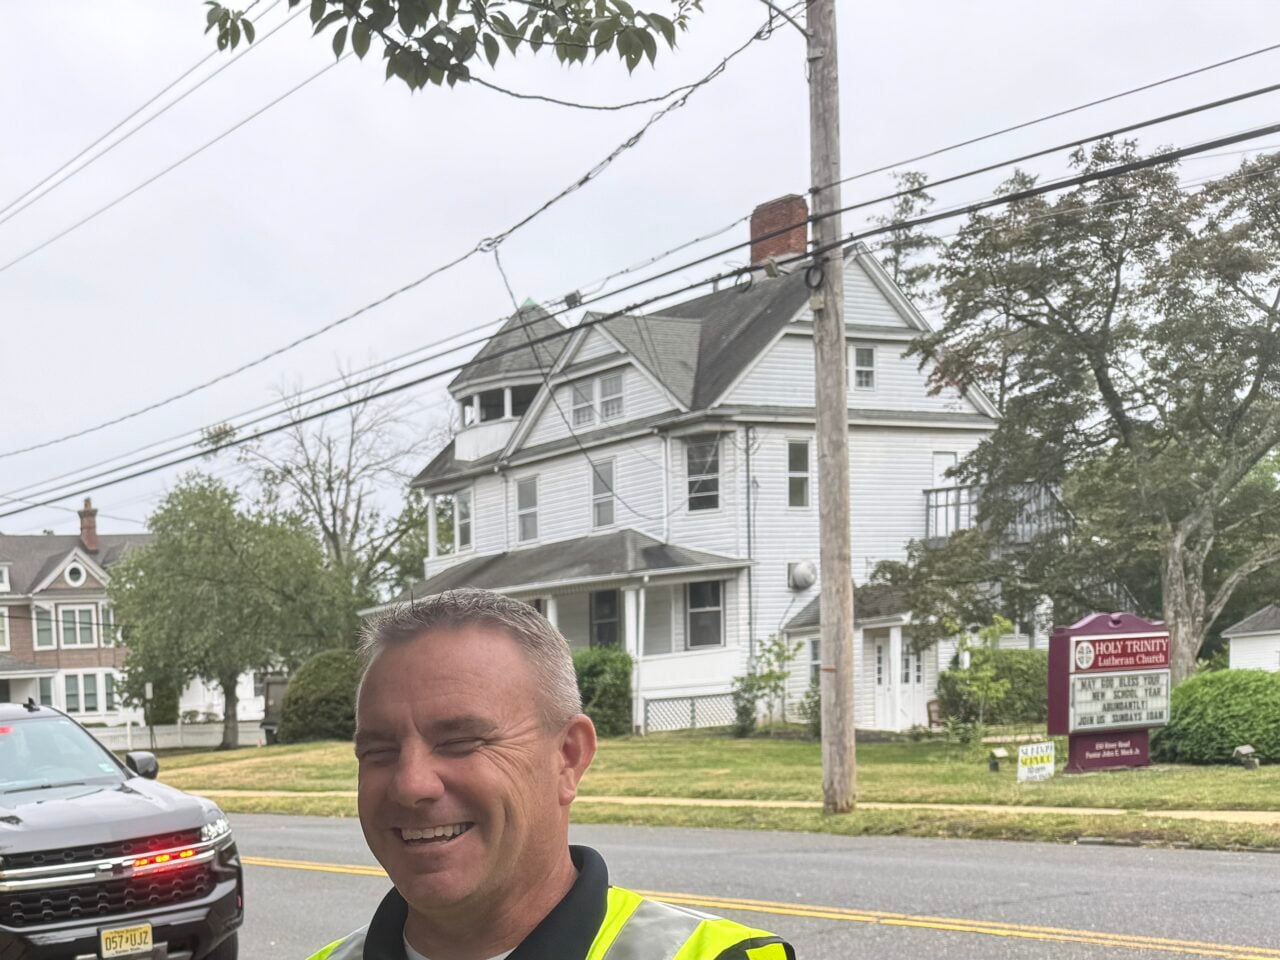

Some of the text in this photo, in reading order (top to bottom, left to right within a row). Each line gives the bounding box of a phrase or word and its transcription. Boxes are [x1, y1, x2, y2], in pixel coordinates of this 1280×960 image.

[1095, 638, 1169, 655] HOLY TRINITY
[1098, 653, 1165, 667] Lutheran Church
[1081, 675, 1160, 690] MAY GOD BLESS YOUR
[1092, 687, 1161, 701] NEW SCHOOL YEAR
[1078, 715, 1094, 726] JOIN
[1097, 714, 1105, 724] US
[1112, 711, 1142, 722] SUNDAYS
